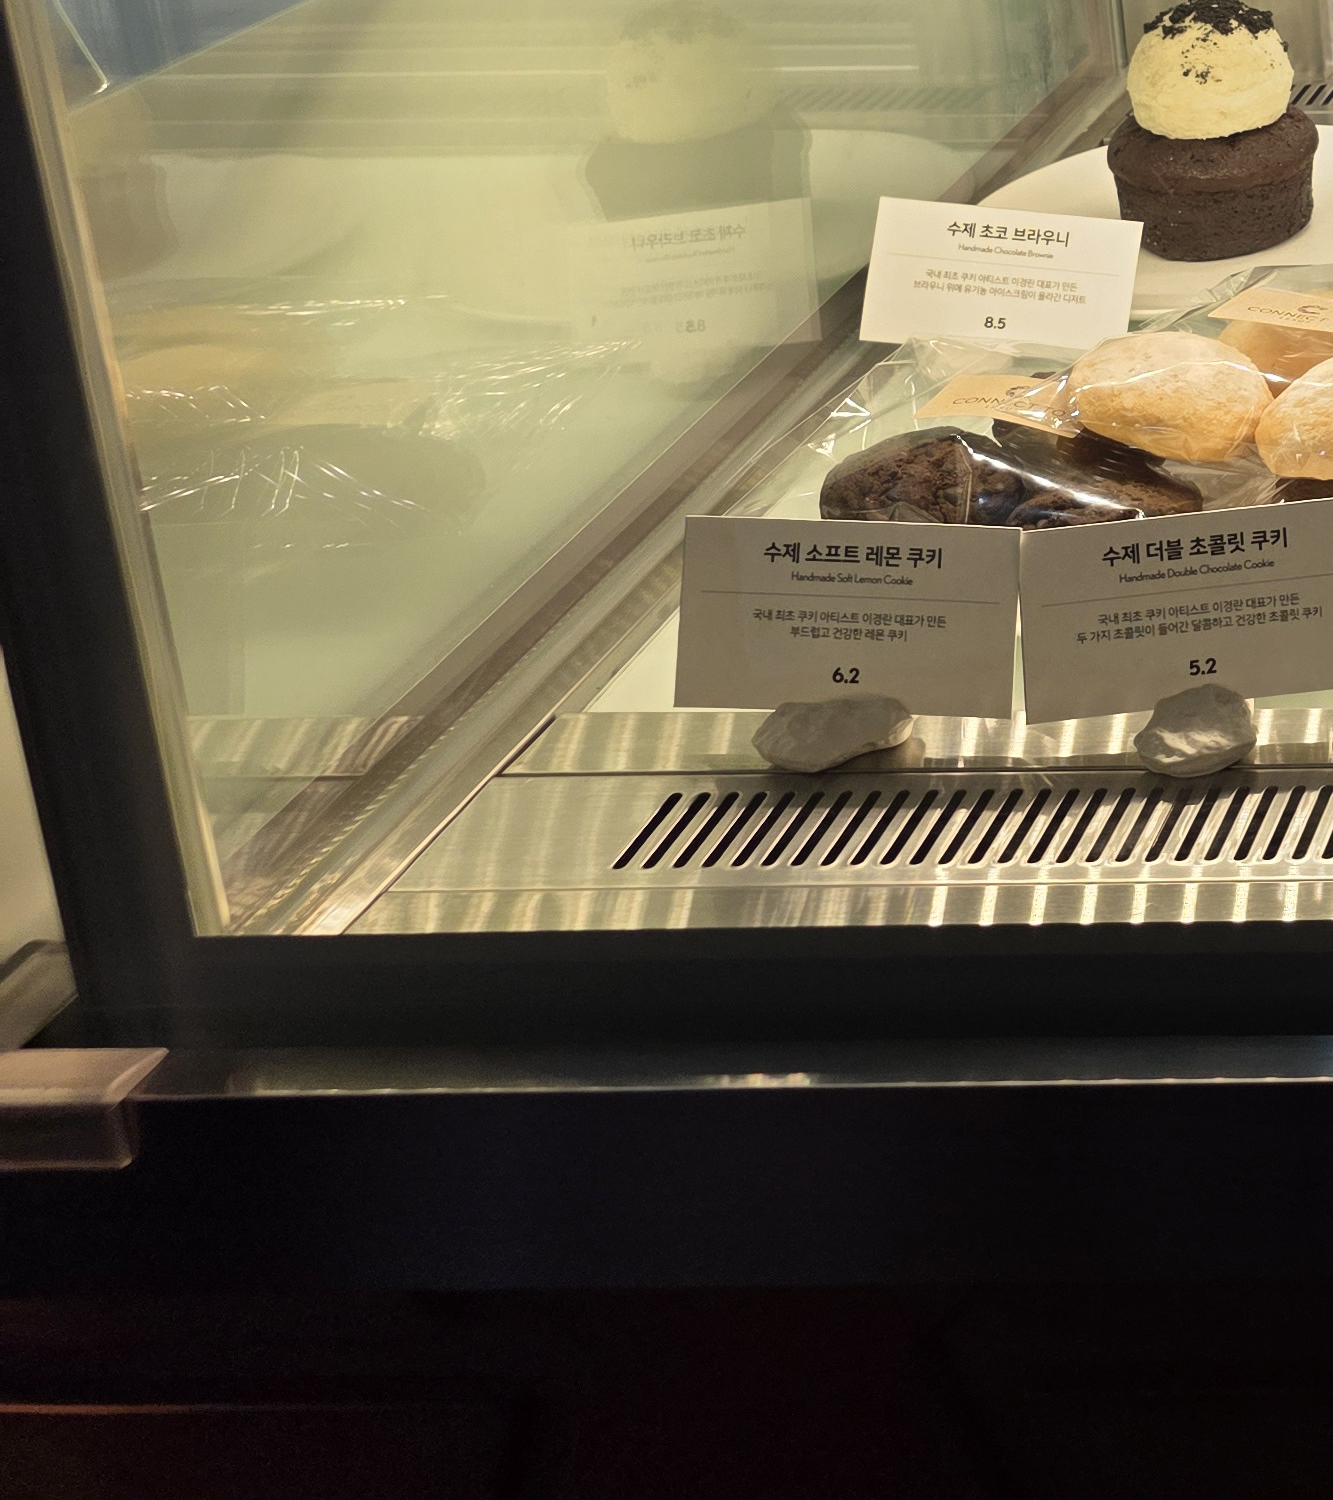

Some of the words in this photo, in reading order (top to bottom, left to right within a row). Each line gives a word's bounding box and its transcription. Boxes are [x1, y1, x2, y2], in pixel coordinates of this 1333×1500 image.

[946, 221, 977, 239] 수제
[979, 224, 1008, 240] 초코
[1011, 227, 1070, 248] 브라우니
[983, 316, 1007, 330] 8.5
[763, 541, 801, 564] 수제
[804, 543, 861, 564] 소프트
[865, 545, 903, 568] 레몬
[906, 547, 943, 570] 쿠키
[1101, 542, 1141, 567] 수제
[1145, 538, 1184, 562] 더블
[1188, 531, 1246, 557] 초콜릿
[1250, 526, 1288, 551] 쿠키
[791, 571, 837, 583] Handmade
[836, 572, 854, 584] Soft
[853, 573, 883, 585] Lemon
[882, 574, 914, 586] Cookie
[1118, 569, 1166, 584] Handmade
[1166, 565, 1198, 579] Double
[1198, 561, 1243, 575] Chocolate
[1243, 558, 1276, 570] Cookie
[832, 666, 860, 684] 6.2
[1189, 657, 1218, 676] 5.2
